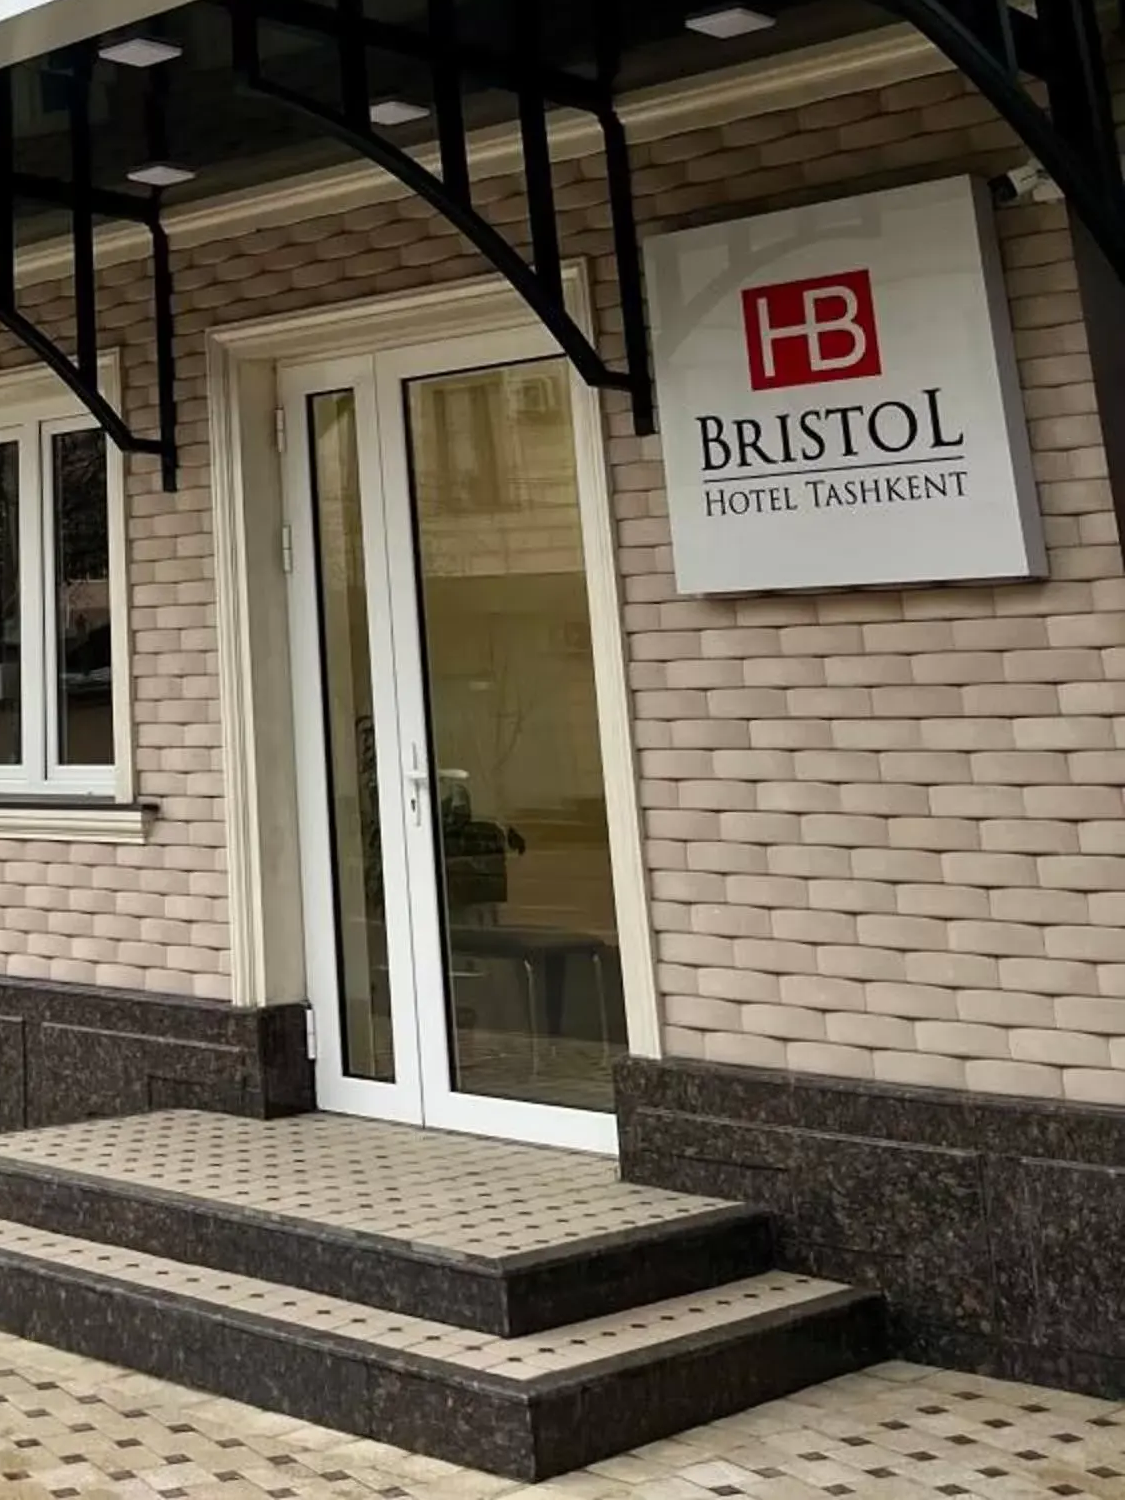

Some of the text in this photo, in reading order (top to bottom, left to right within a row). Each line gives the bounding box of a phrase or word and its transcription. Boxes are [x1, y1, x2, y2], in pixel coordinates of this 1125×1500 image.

[756, 285, 866, 377] HB
[696, 387, 964, 472] BRISTOL
[705, 471, 968, 517] HOTEL TASHKENT
